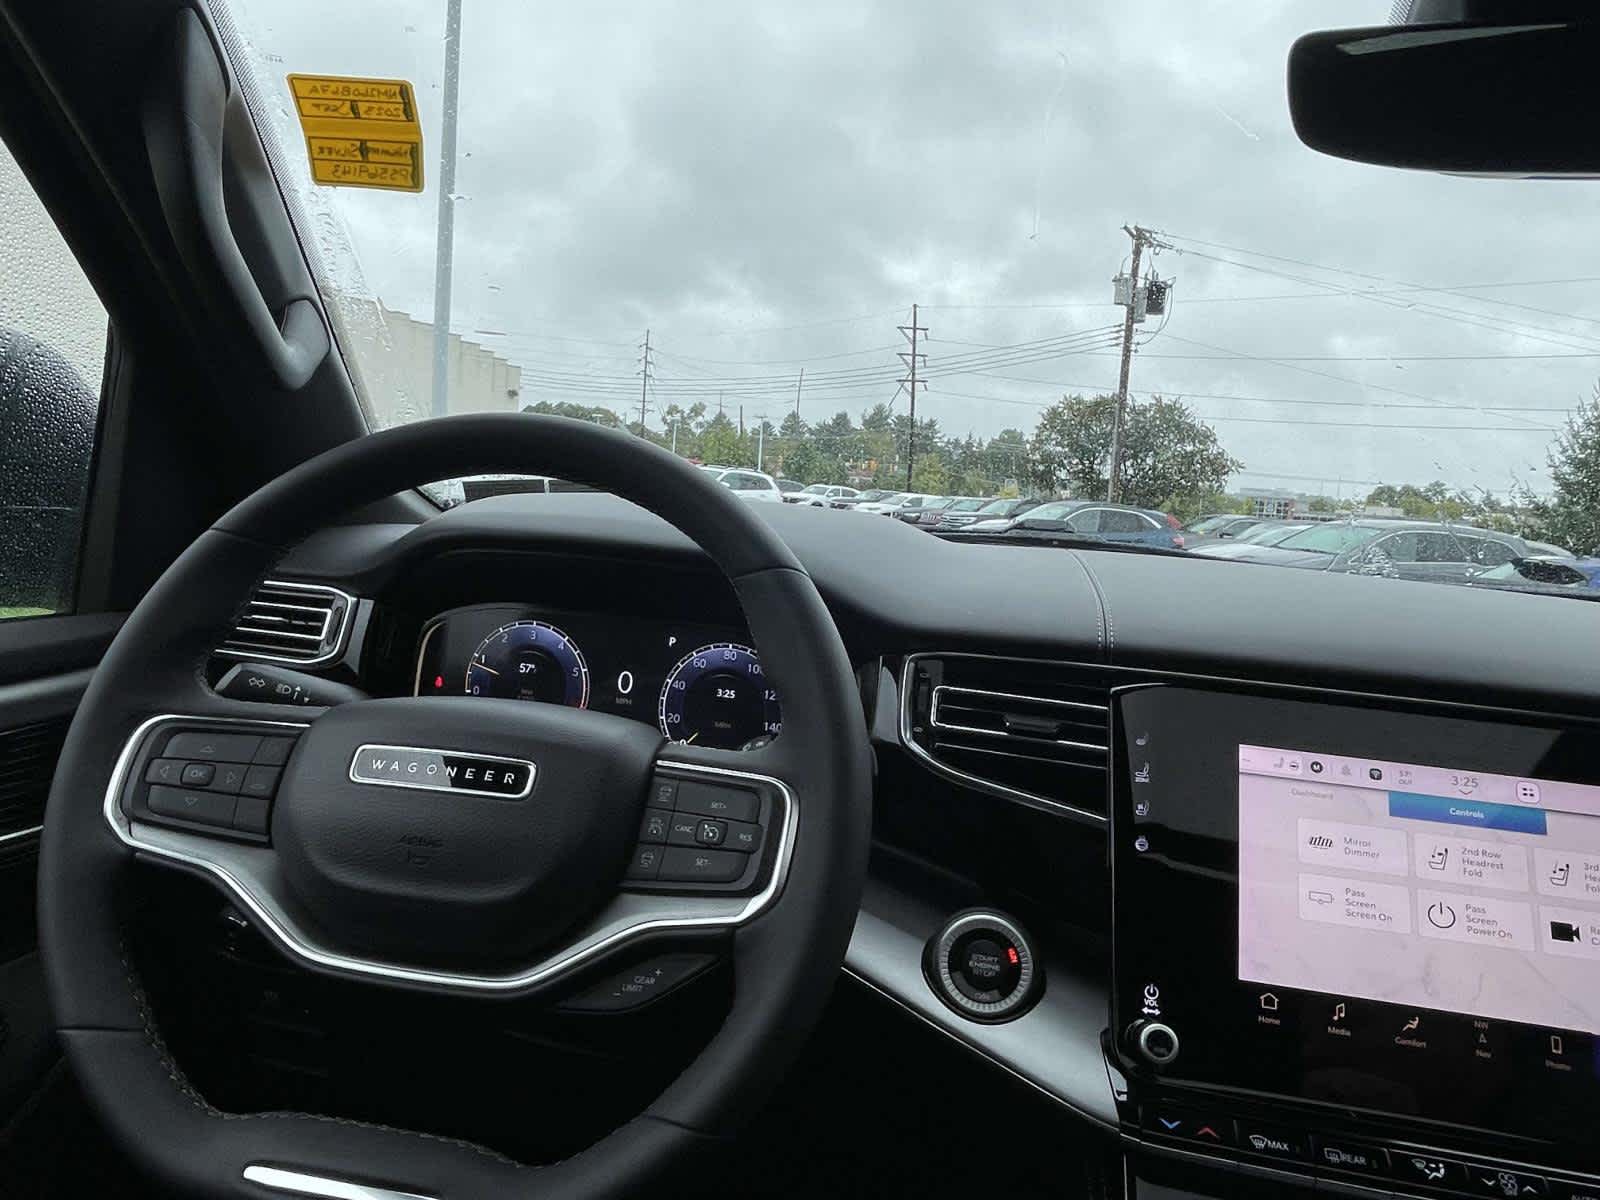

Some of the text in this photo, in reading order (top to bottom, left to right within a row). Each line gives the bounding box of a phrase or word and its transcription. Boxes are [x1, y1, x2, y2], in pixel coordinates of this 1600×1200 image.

[502, 633, 509, 643] 2
[530, 630, 536, 640] 3
[558, 641, 565, 650] 4
[668, 636, 677, 647] P
[481, 654, 486, 664] 1
[723, 650, 737, 661] 80
[692, 658, 707, 668] 60
[572, 667, 579, 677] 5
[747, 664, 764, 675] 10
[617, 671, 633, 694] 0
[672, 680, 686, 690] 40
[472, 685, 480, 695] 0
[716, 688, 736, 699] 3:25
[764, 690, 776, 701] 12
[667, 713, 681, 724] 20
[371, 758, 515, 785] WAGONEER
[1450, 775, 1479, 788] 3:25
[1449, 806, 1485, 819] Controls
[1343, 836, 1372, 847] Mirror
[1344, 847, 1381, 859] Dimmer
[1461, 847, 1503, 859] 2nd Row
[1462, 858, 1504, 870] Headrest
[1584, 862, 1600, 872] 3rd
[1463, 868, 1483, 878] Fold
[1345, 887, 1367, 898] Pass
[1345, 898, 1376, 909] Screen
[1465, 903, 1486, 914] Pass
[1345, 908, 1393, 922] Screen On
[1465, 914, 1498, 926] Screen
[1466, 926, 1513, 940] Power On
[1144, 998, 1159, 1007] VOL
[1258, 1015, 1281, 1026] Home
[1328, 1026, 1351, 1036] Media
[1394, 1036, 1427, 1049] Comfort
[1475, 1048, 1492, 1059] Nav
[1268, 1139, 1289, 1151] MAX
[1341, 1153, 1367, 1166] REAR
